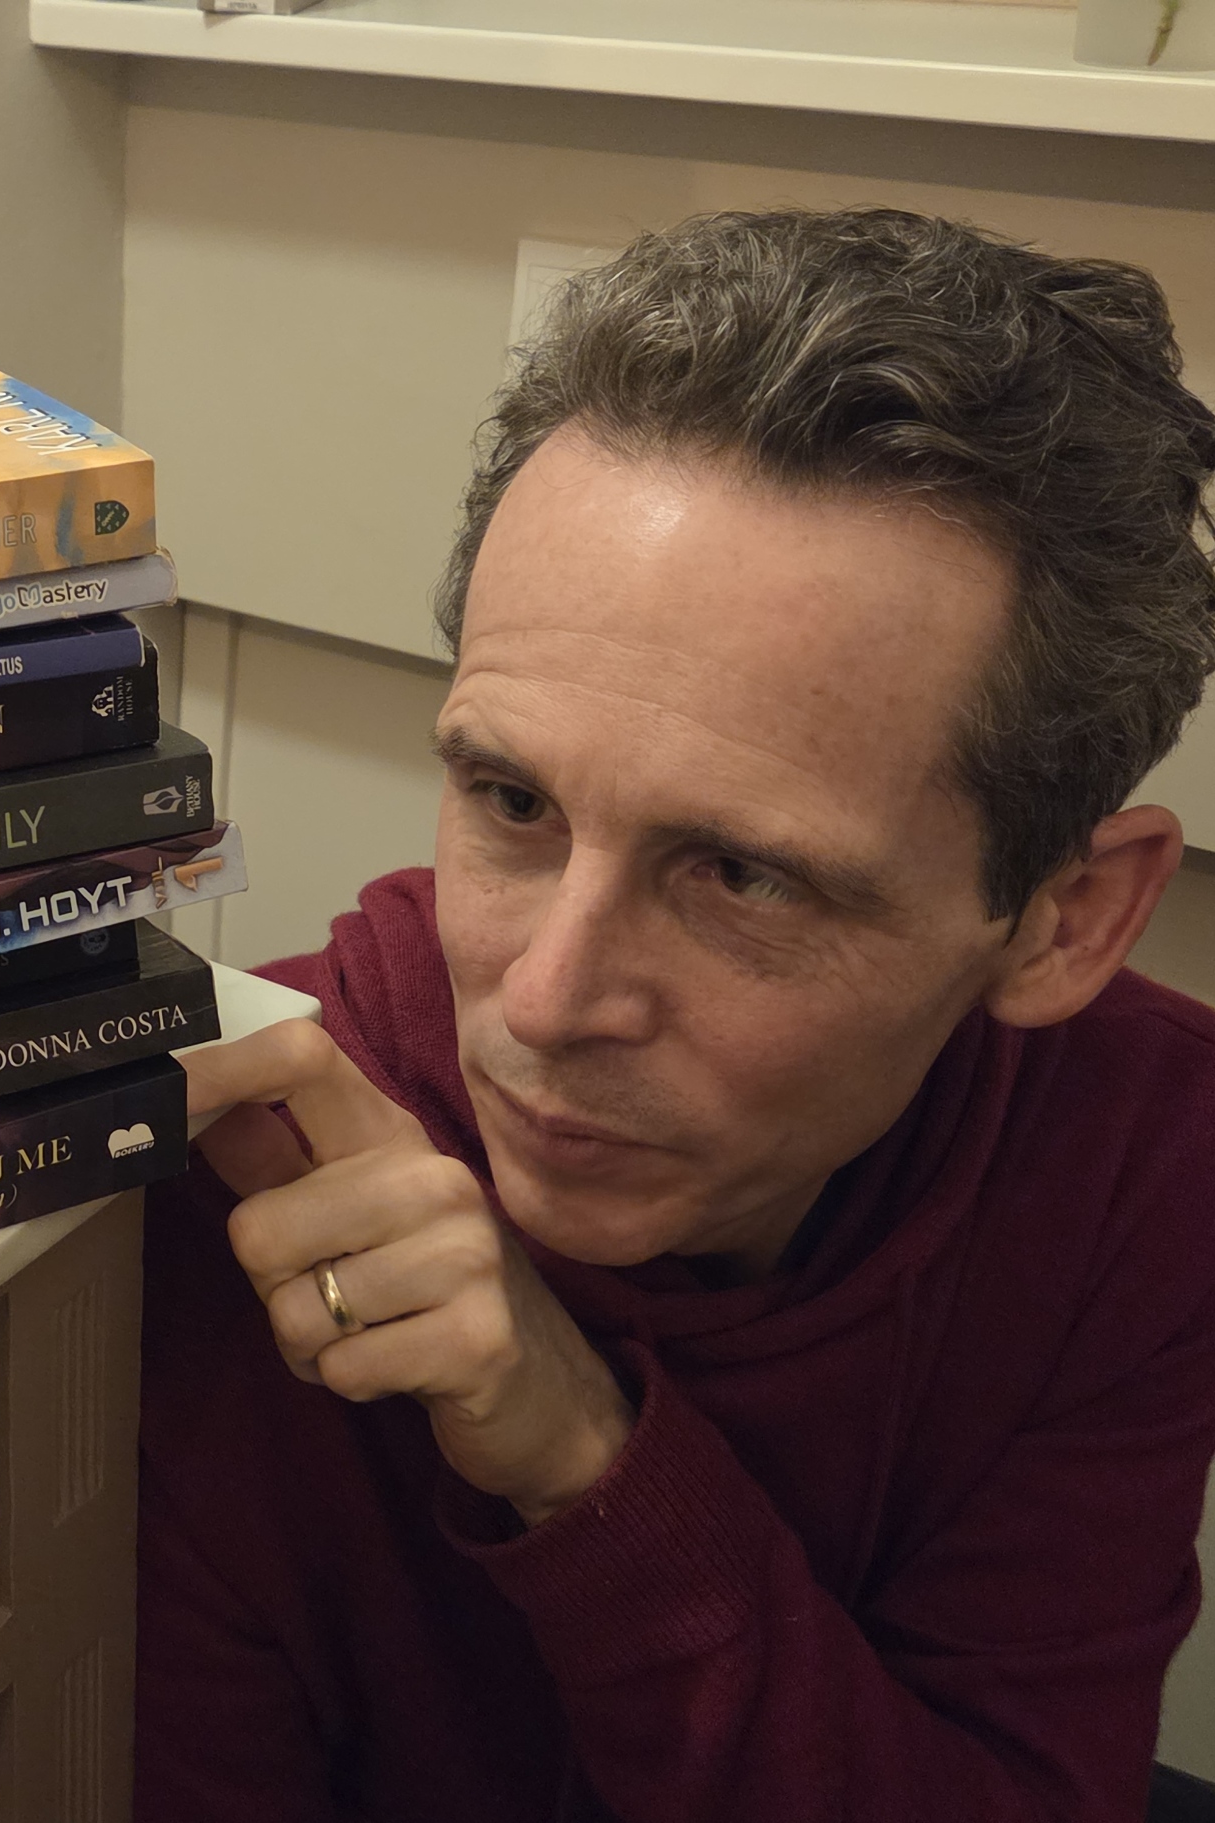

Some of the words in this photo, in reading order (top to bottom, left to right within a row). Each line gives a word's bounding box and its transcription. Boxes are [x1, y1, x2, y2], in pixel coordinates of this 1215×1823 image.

[116, 675, 125, 722] RANDOM
[125, 679, 133, 716] HOUSE
[19, 876, 133, 932] HOYT
[98, 1004, 188, 1044] COSTA
[17, 1135, 73, 1175] ME
